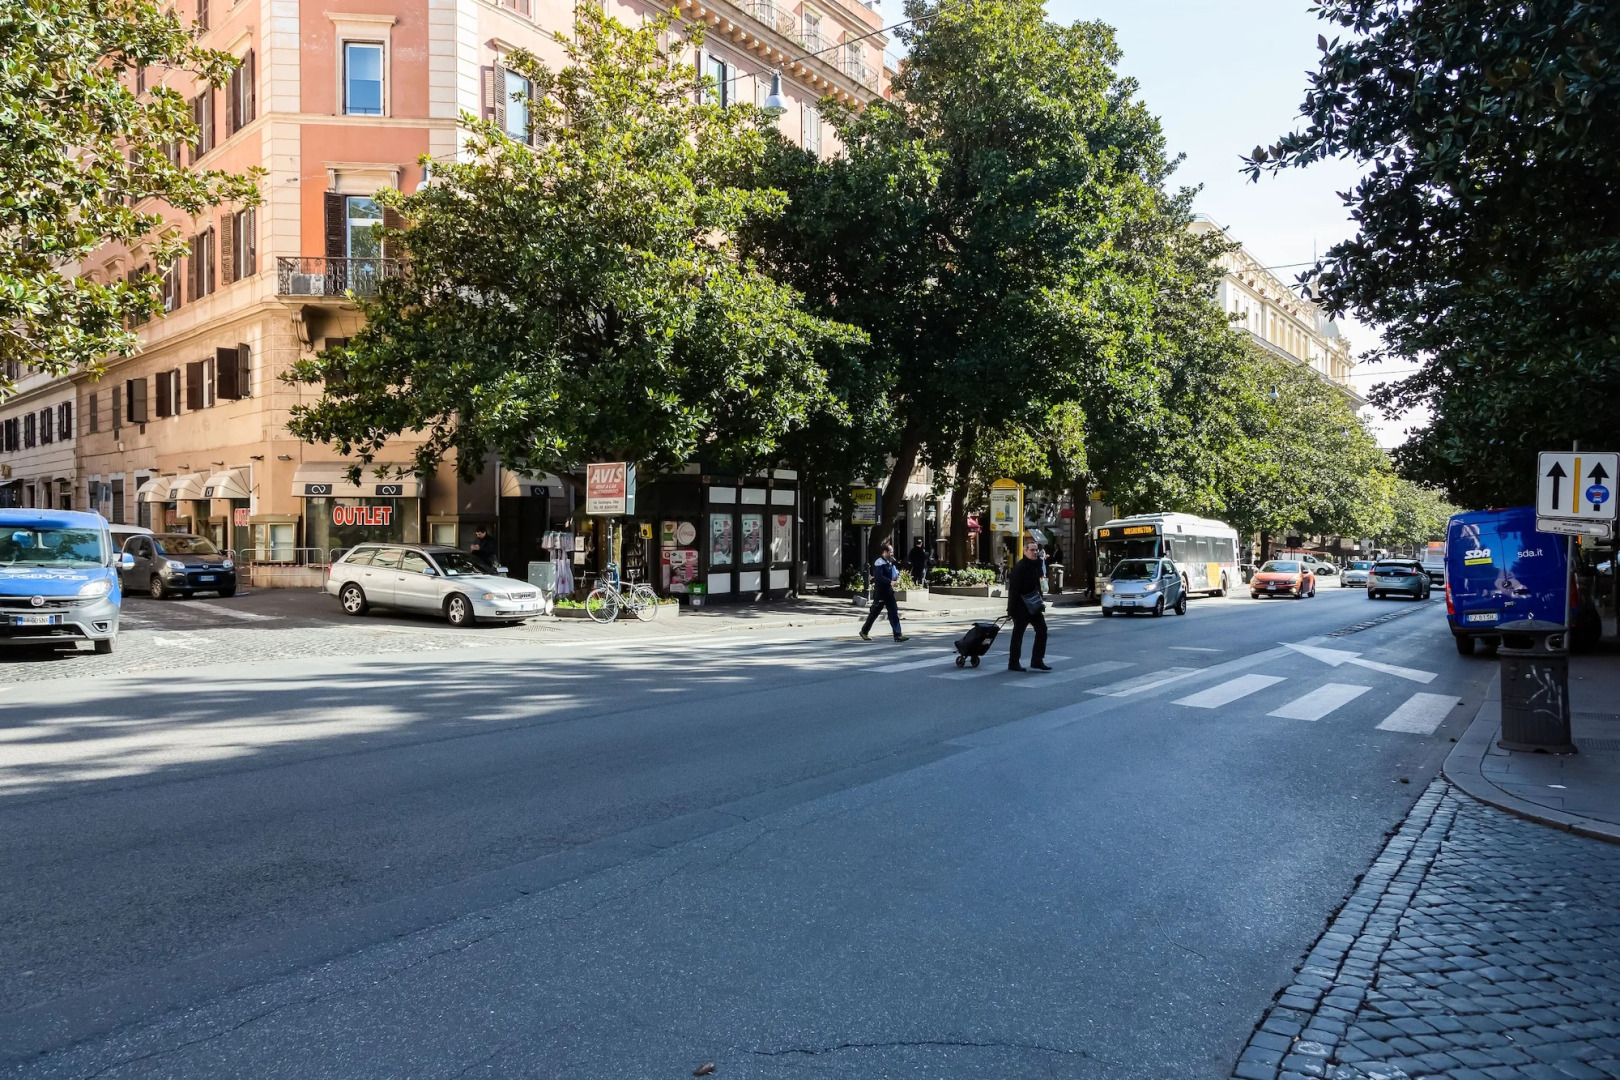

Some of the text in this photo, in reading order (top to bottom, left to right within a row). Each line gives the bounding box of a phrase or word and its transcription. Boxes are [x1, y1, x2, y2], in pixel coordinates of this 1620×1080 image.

[590, 467, 623, 484] AVIS
[855, 492, 873, 500] Hertz
[333, 506, 392, 525] OUTLET
[1100, 529, 1110, 537] 160
[1464, 548, 1543, 559] SDA sda.it
